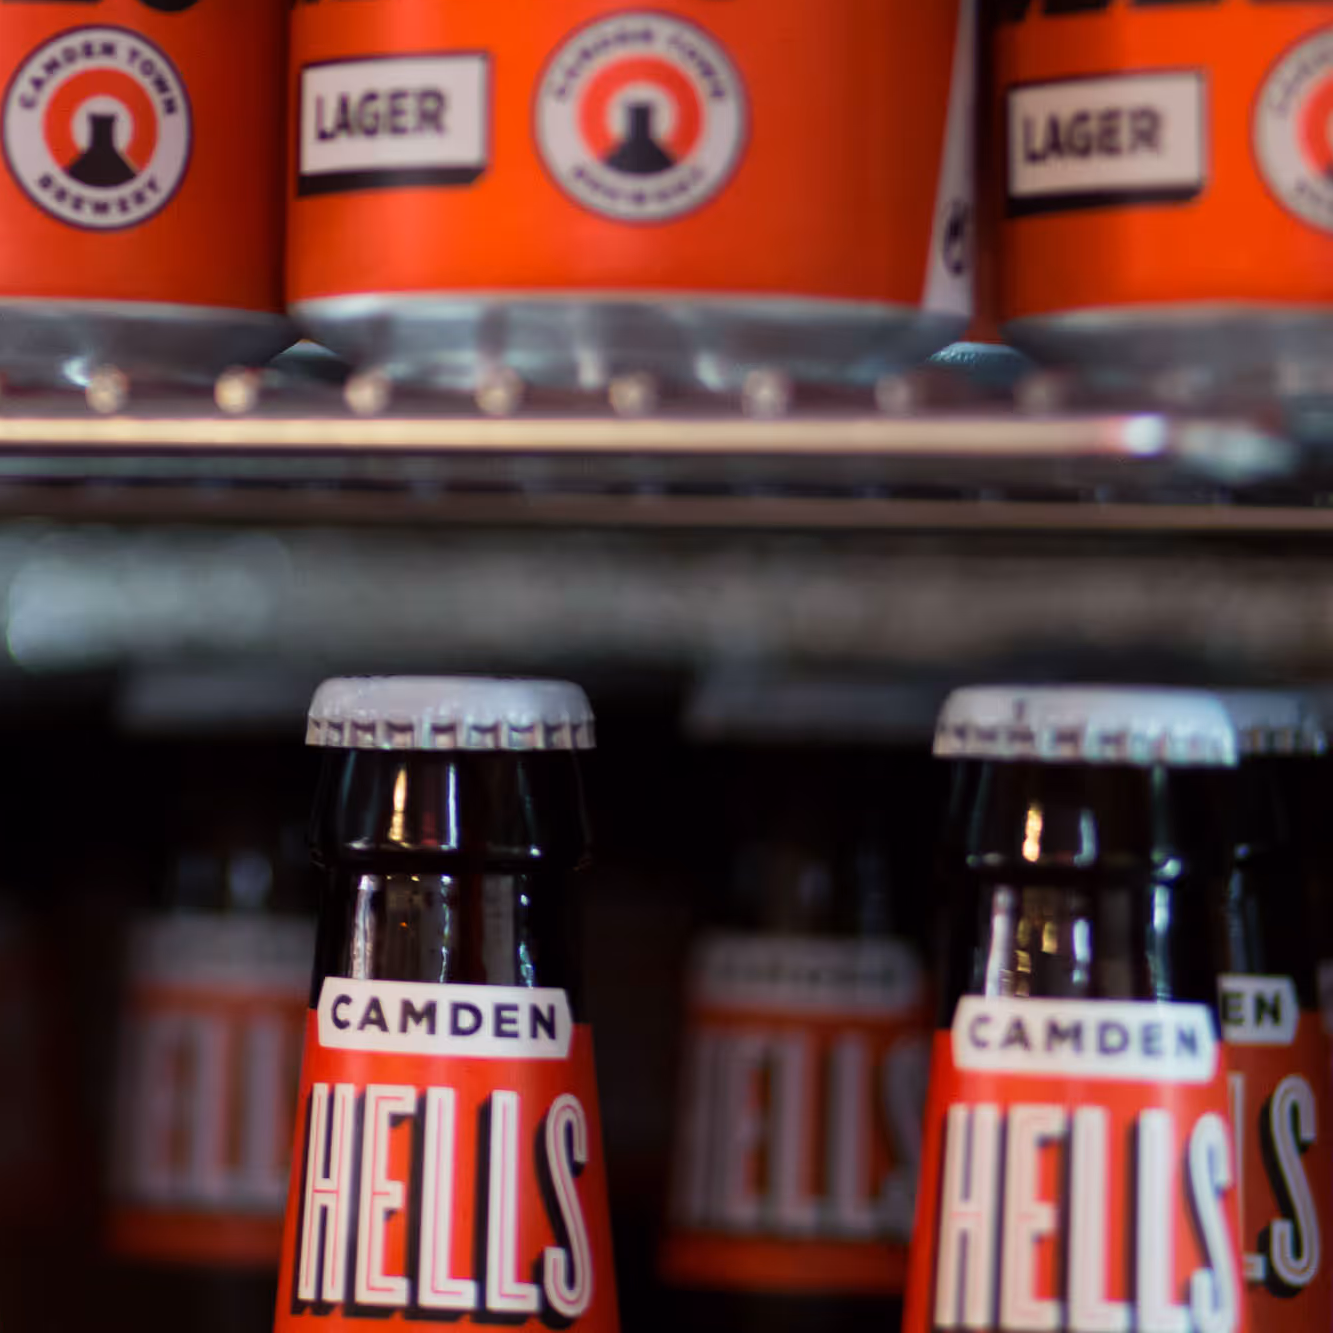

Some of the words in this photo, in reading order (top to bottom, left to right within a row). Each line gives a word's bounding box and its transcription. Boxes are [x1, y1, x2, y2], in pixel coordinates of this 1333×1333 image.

[19, 41, 117, 110] CAMDEN
[126, 46, 177, 115] TOWN
[314, 87, 446, 143] LAGER
[1021, 107, 1165, 166] LAGER
[330, 993, 558, 1040] CAMDEN
[967, 1013, 1202, 1060] CAMDEN
[290, 1082, 593, 1325] HELLS
[934, 1102, 1235, 1333] HELLS
